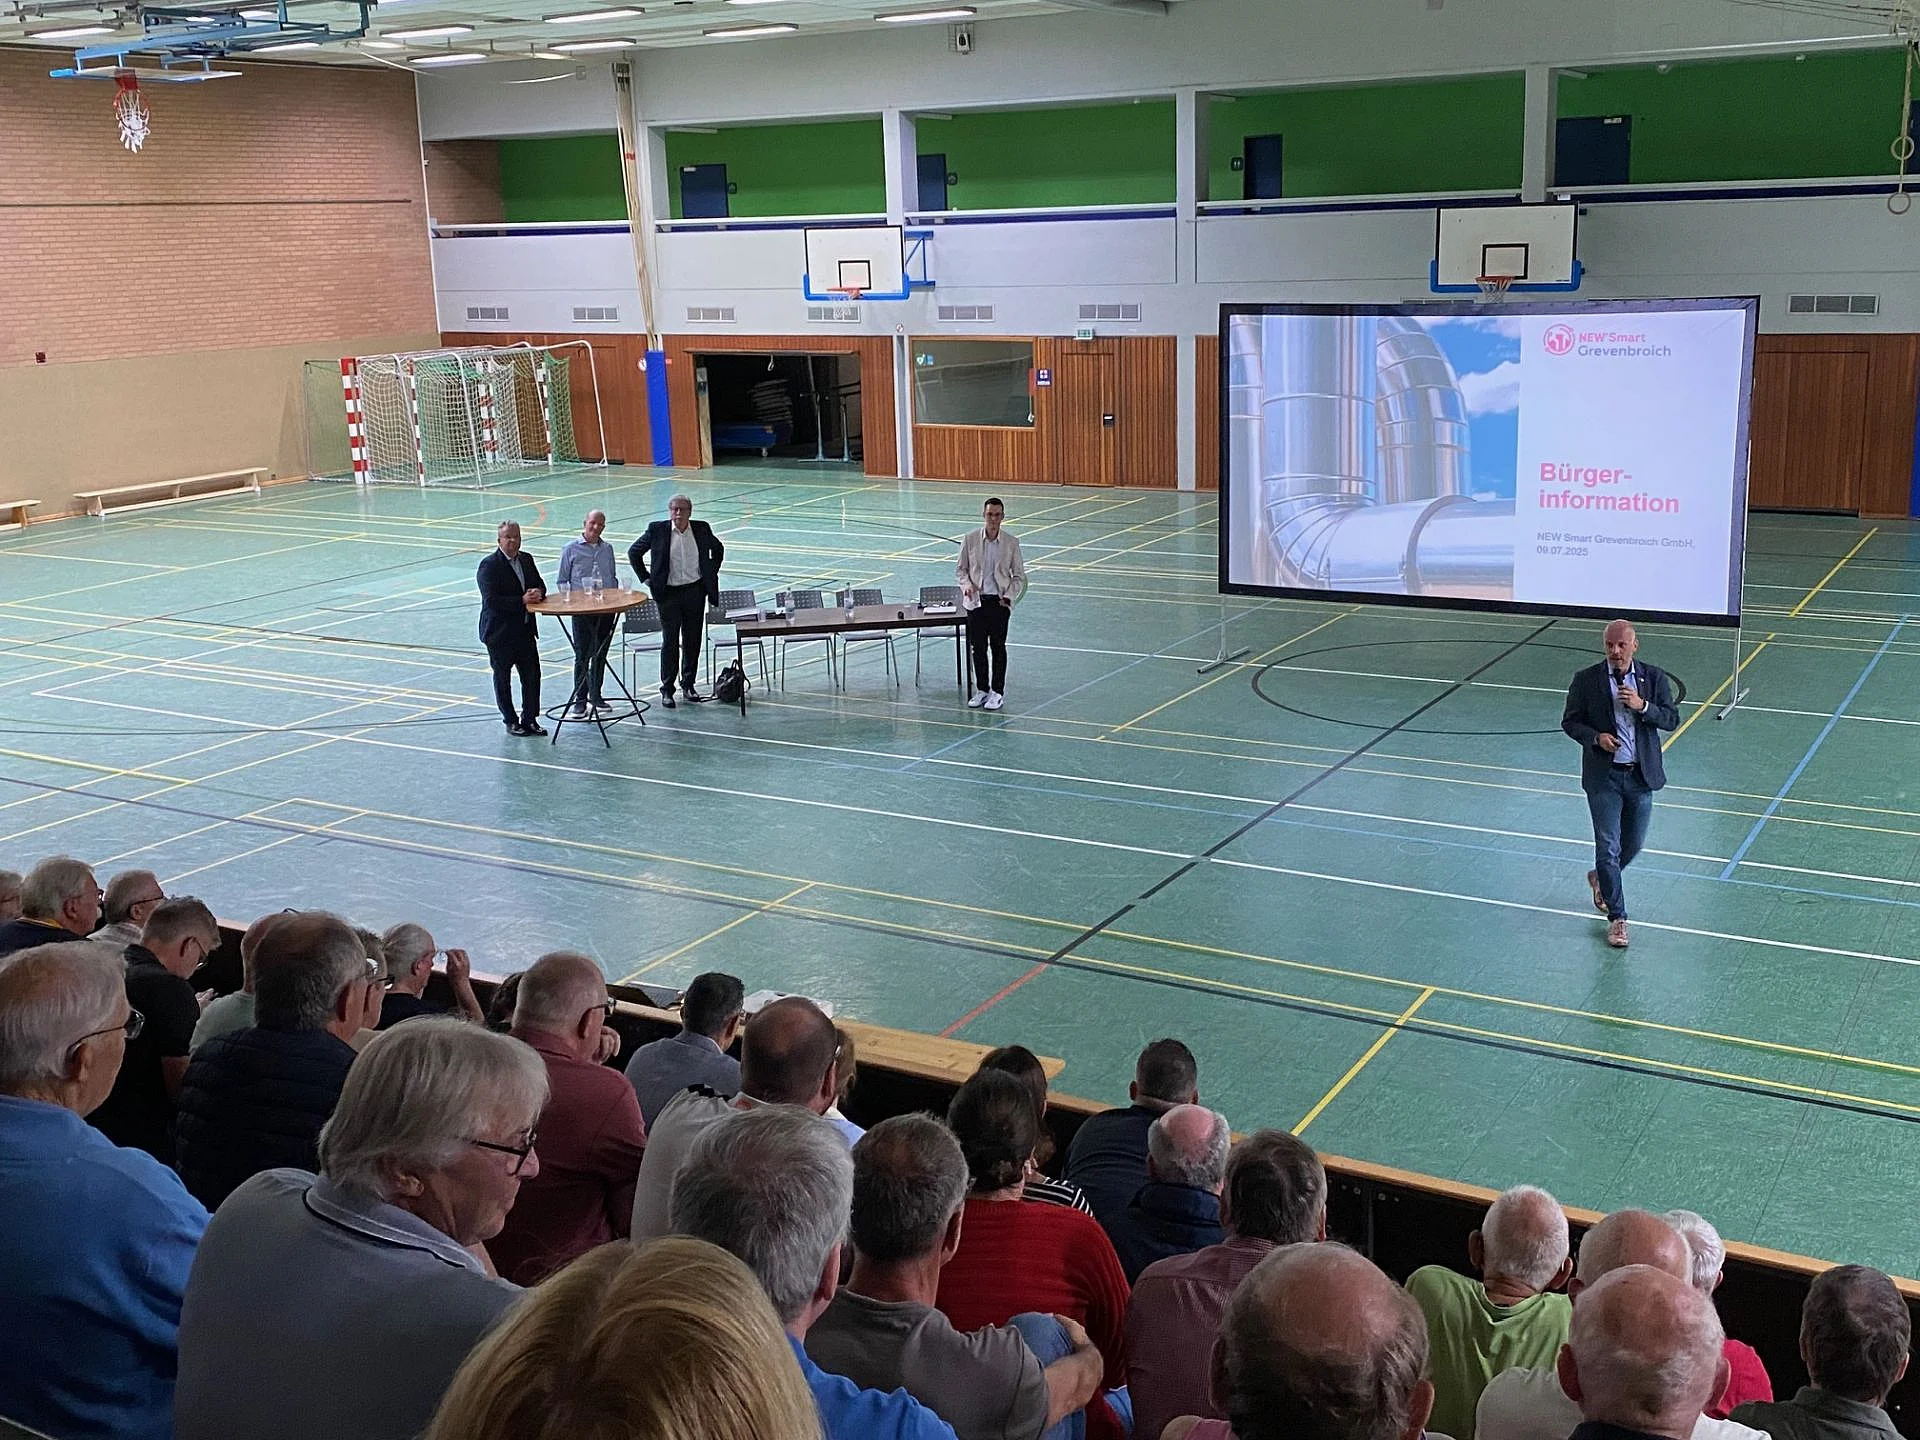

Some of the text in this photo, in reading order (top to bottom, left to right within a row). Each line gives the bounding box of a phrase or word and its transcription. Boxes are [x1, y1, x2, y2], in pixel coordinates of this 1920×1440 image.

[1577, 345, 1672, 357] Grevenbroich
[1540, 462, 1632, 488] Bürger-
[1539, 489, 1680, 513] information
[1536, 531, 1561, 542] NEW
[1563, 532, 1593, 543] Smart
[1594, 534, 1658, 546] Grevenbroich
[1536, 544, 1589, 557] 09.07.2025
